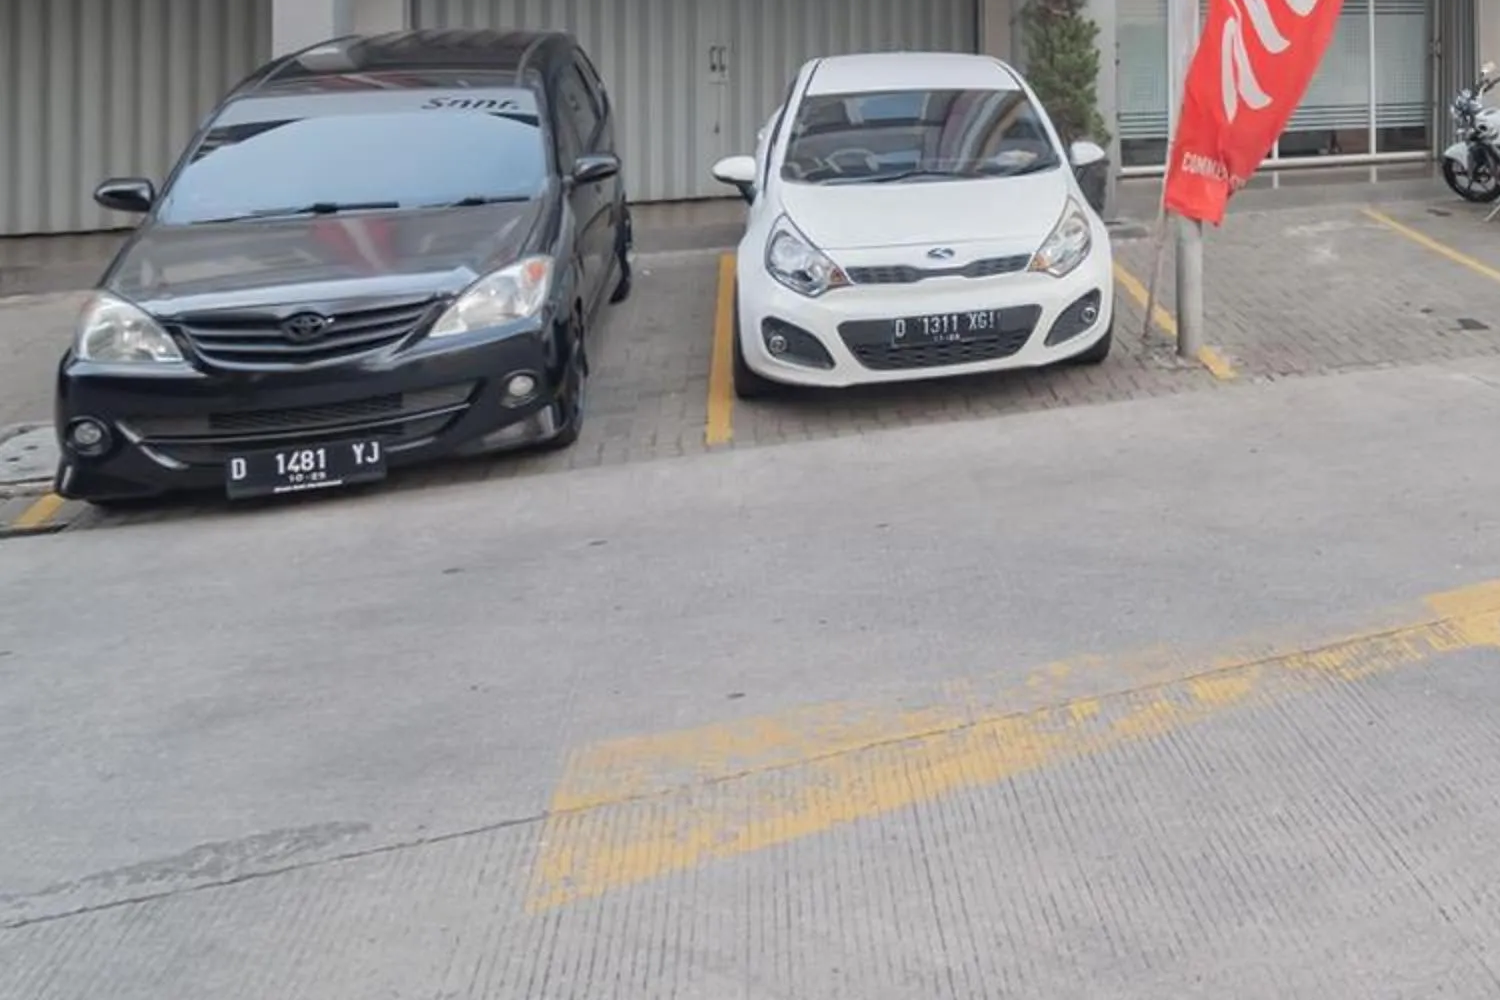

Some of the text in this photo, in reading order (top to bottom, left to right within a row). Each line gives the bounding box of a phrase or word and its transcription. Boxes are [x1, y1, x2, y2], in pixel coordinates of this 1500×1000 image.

[230, 441, 381, 481] D 1481 YJ
